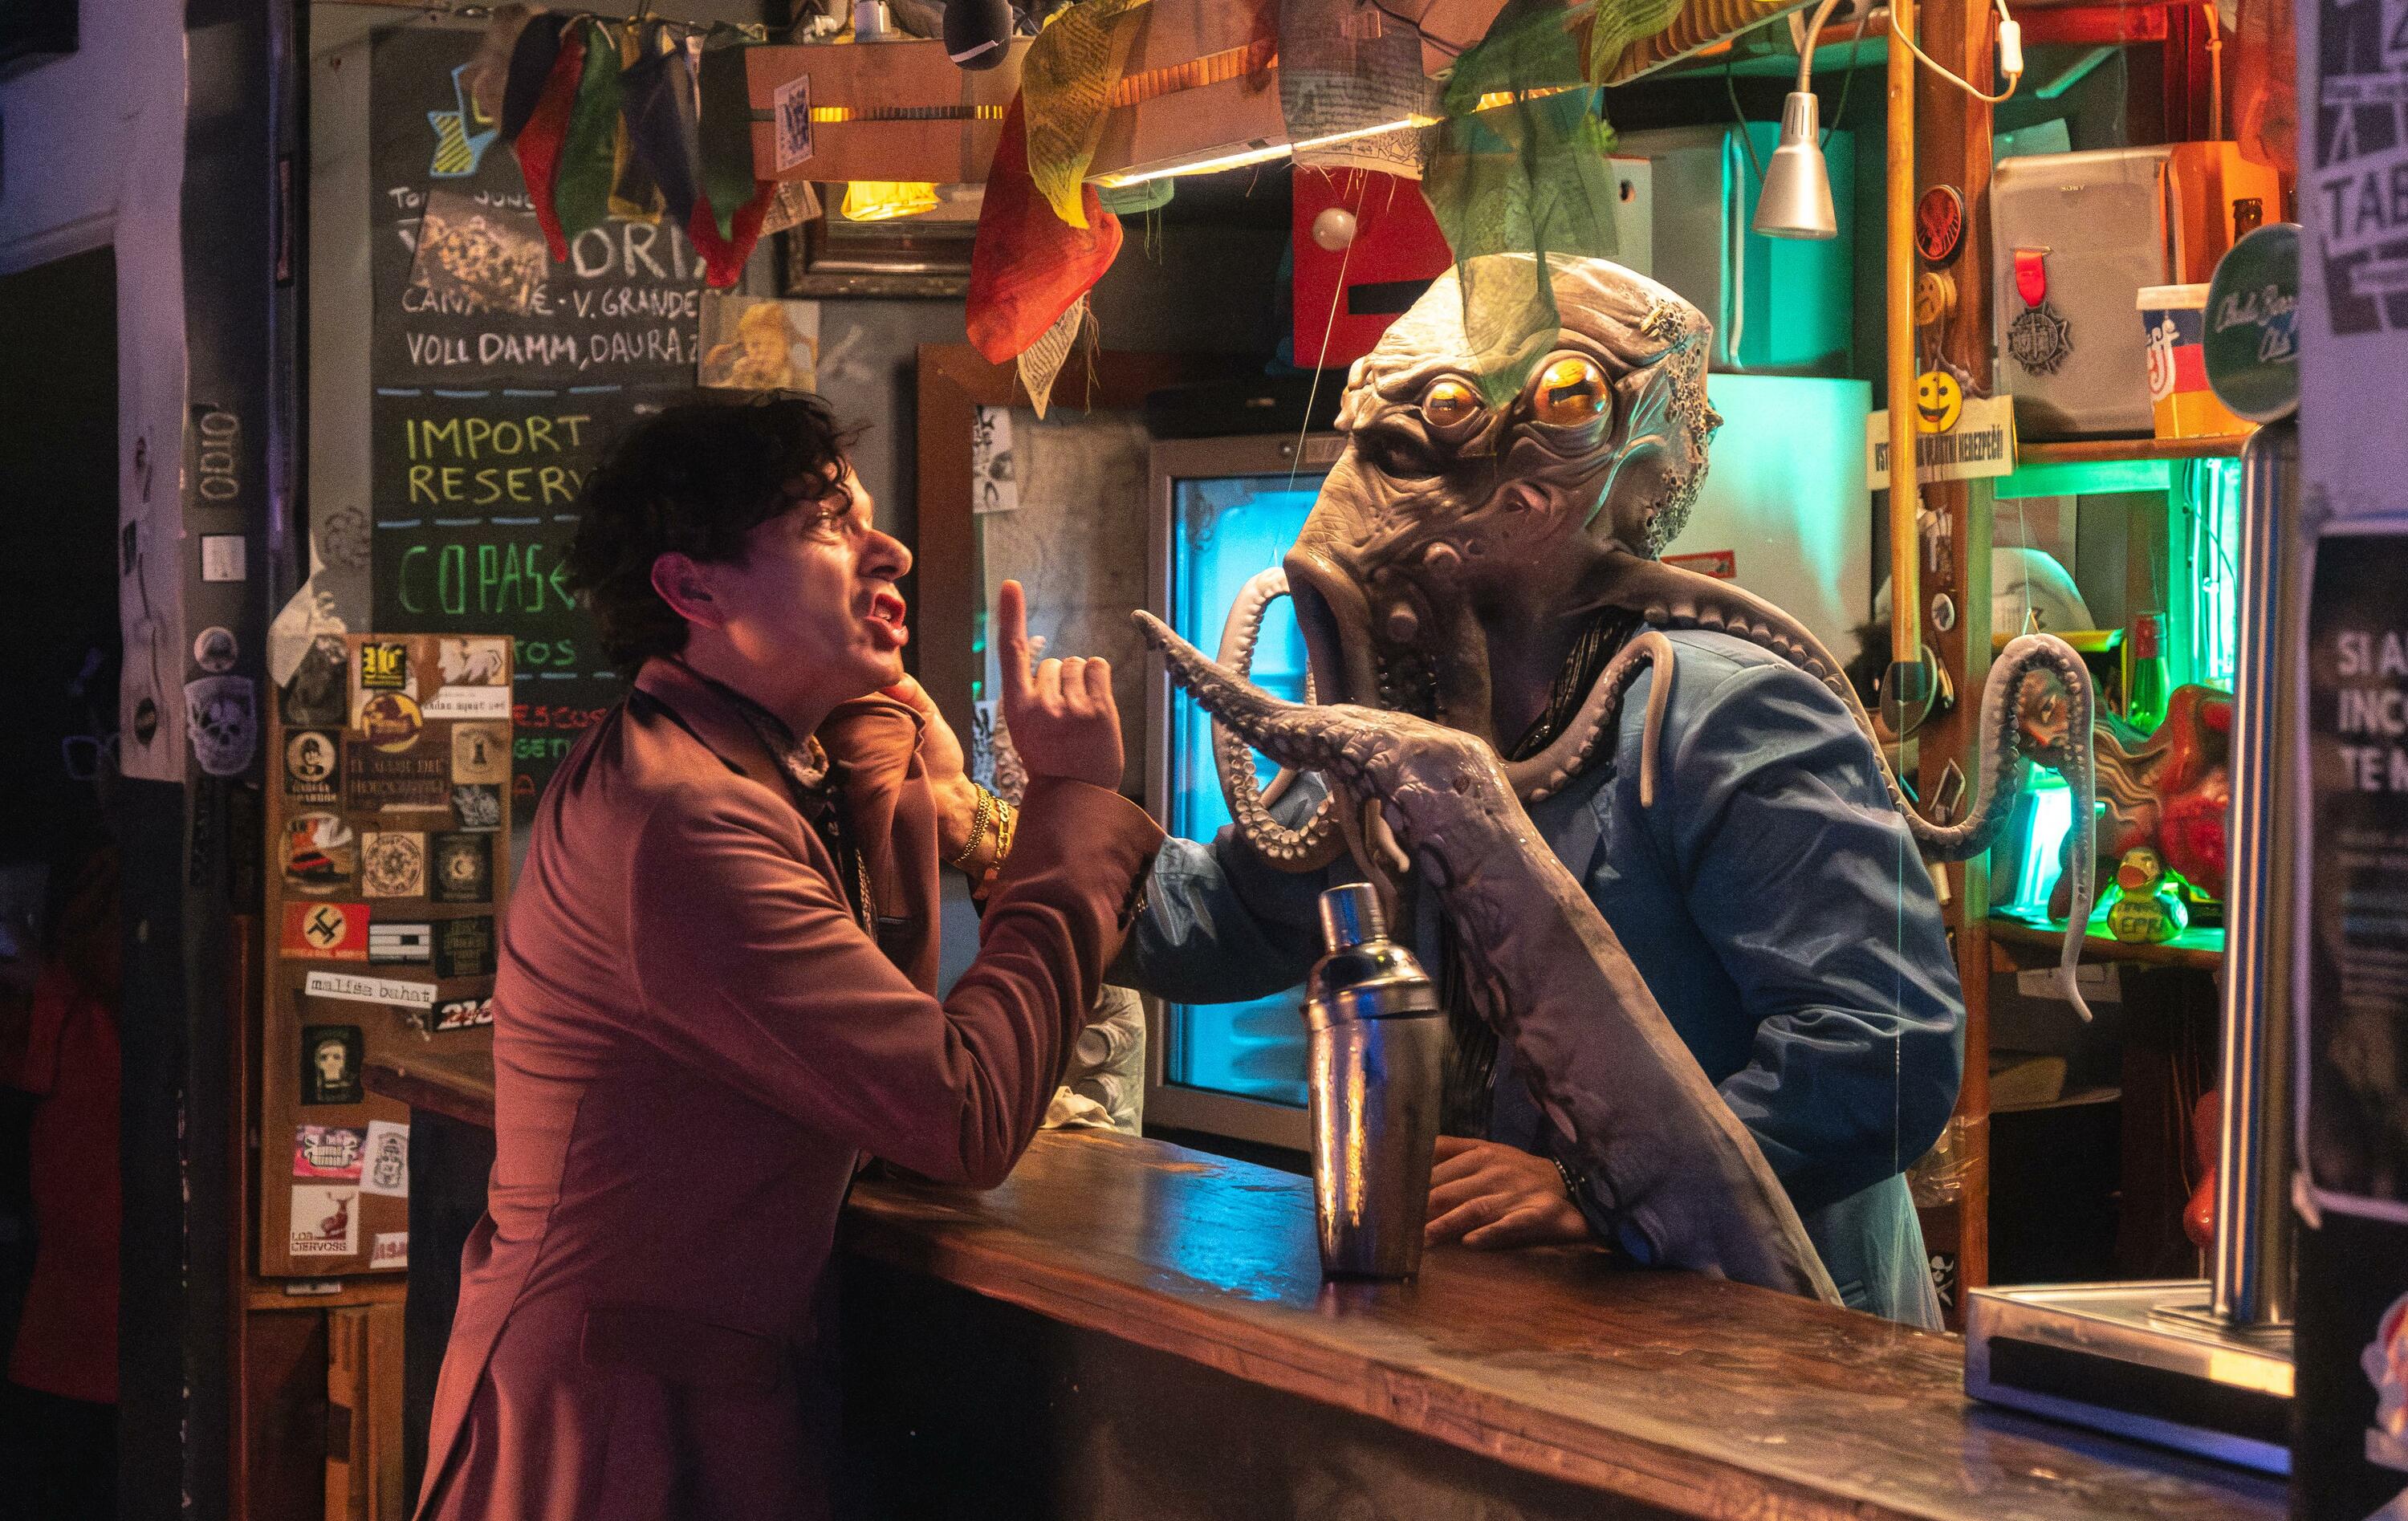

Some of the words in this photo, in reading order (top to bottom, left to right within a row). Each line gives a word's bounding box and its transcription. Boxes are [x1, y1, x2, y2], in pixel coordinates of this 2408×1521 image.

[602, 287, 700, 320] GRANDE
[406, 331, 470, 366] VOLL
[406, 414, 592, 461] IMPORT
